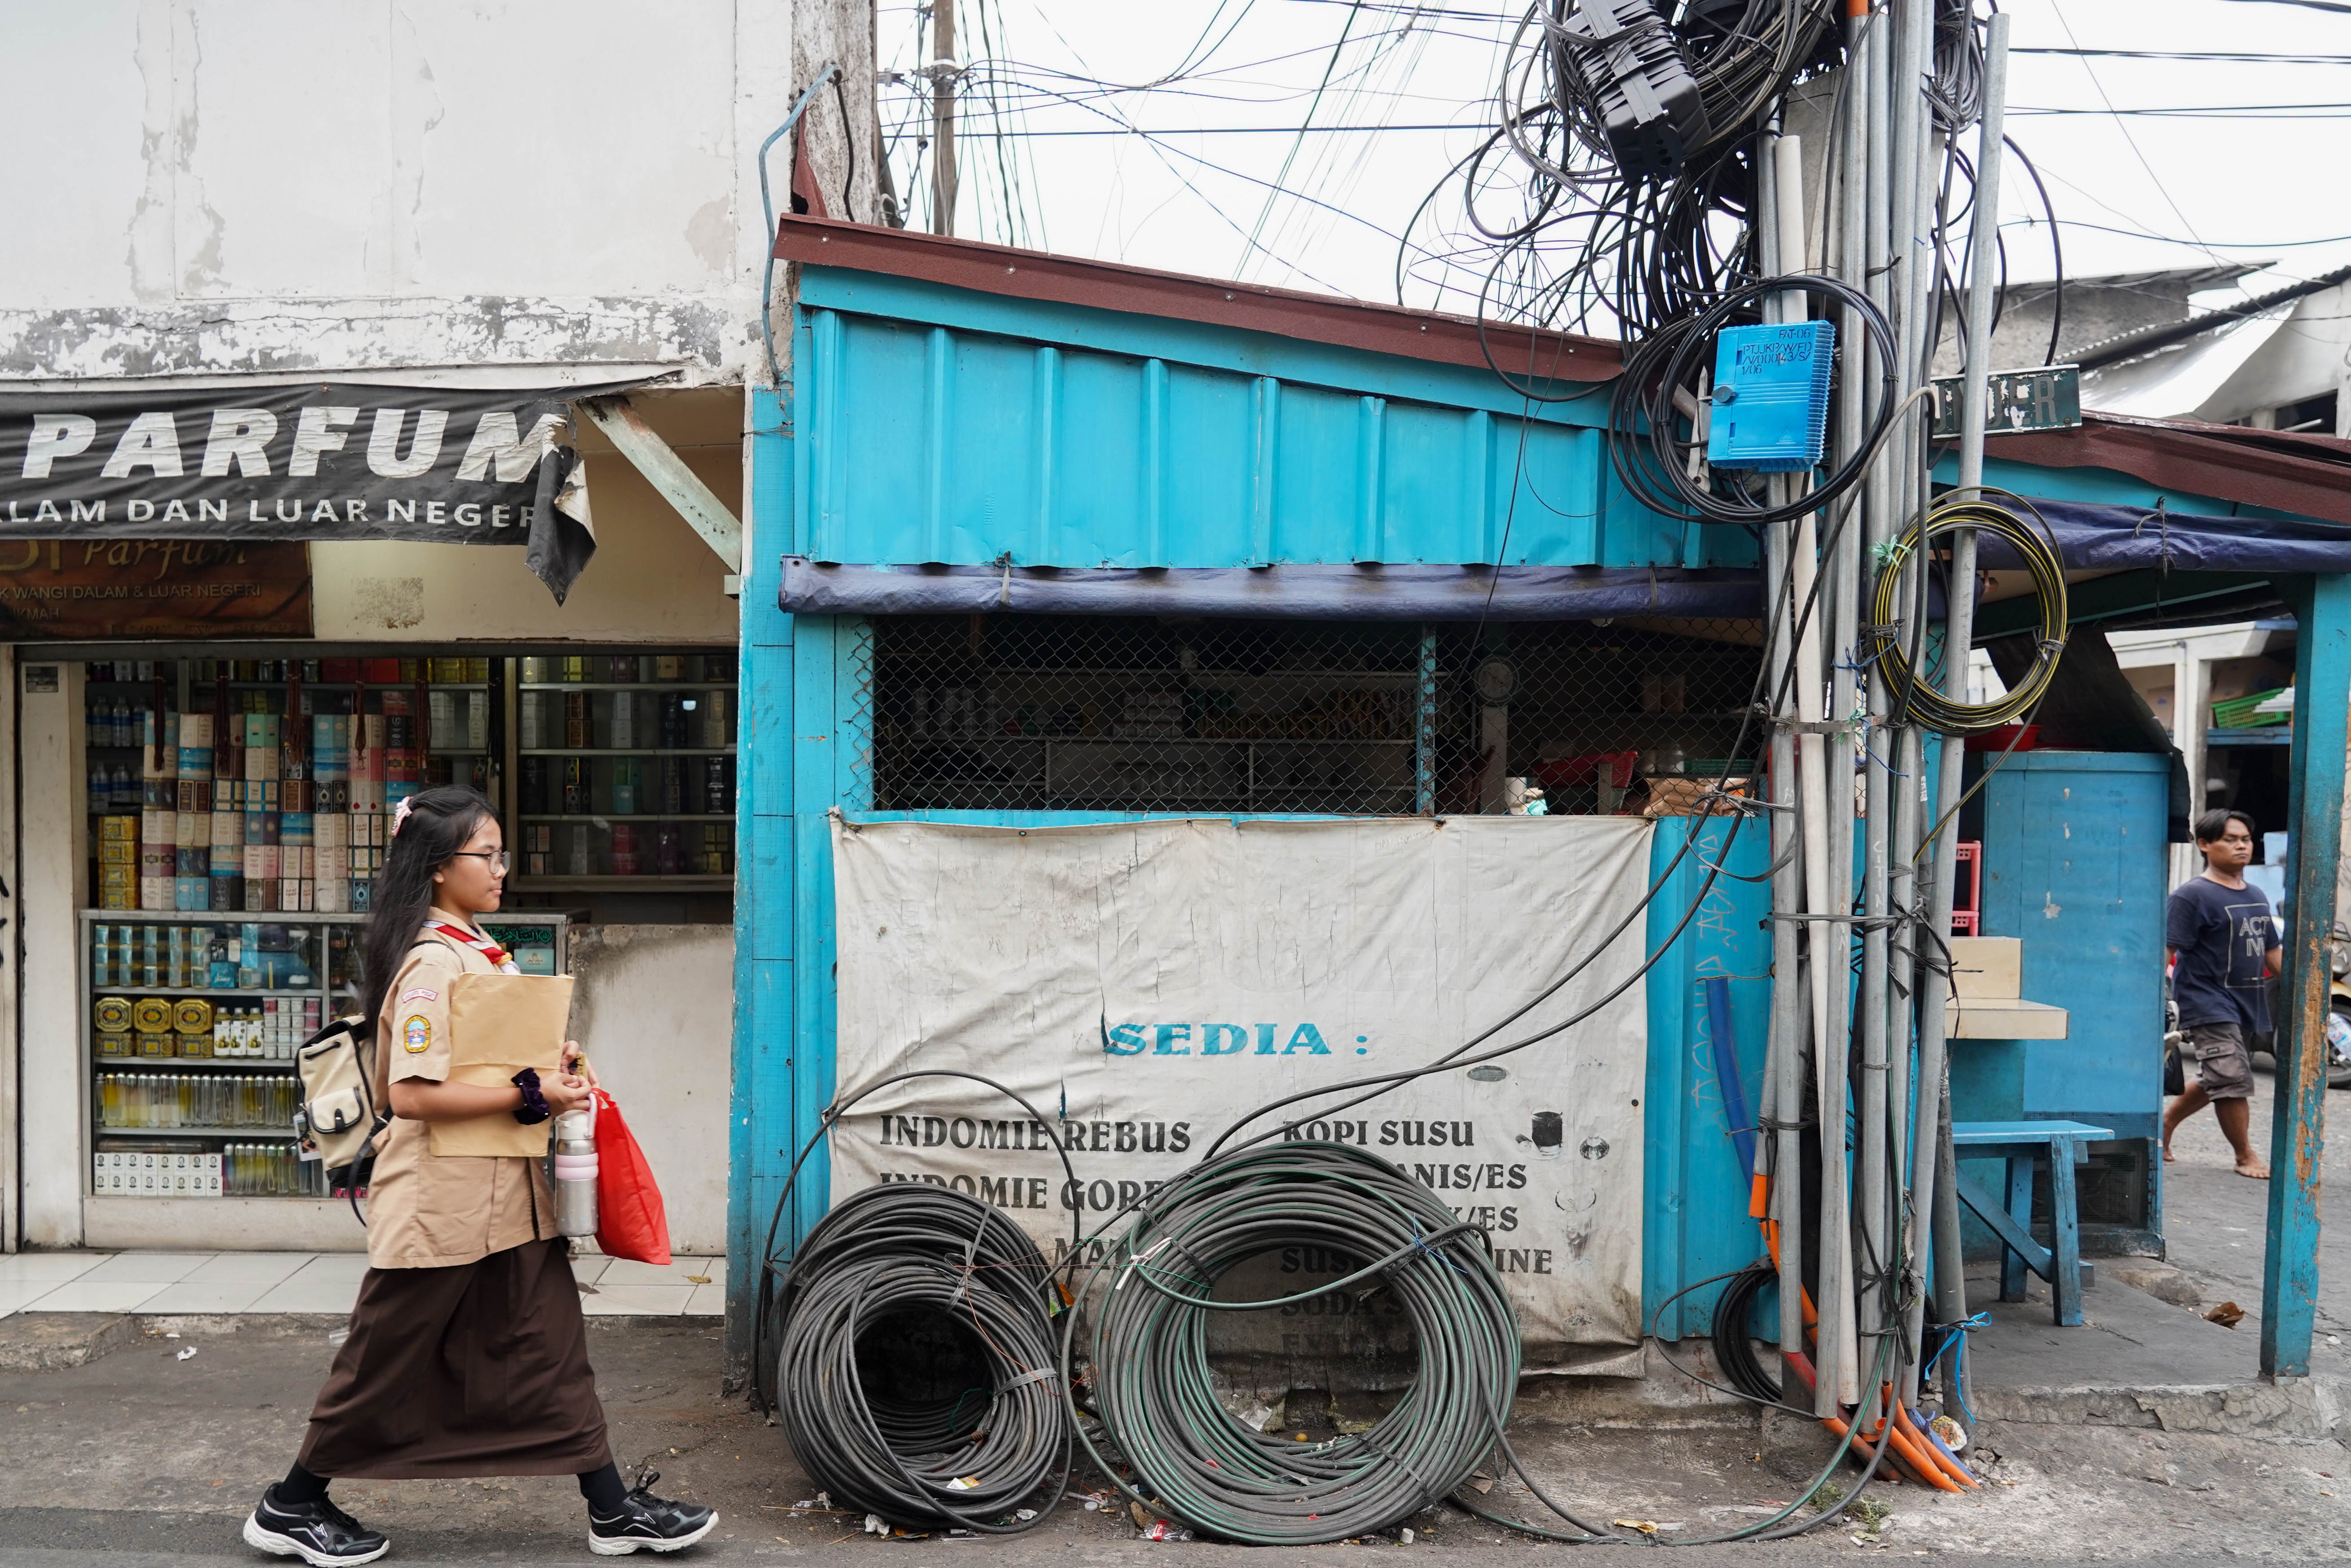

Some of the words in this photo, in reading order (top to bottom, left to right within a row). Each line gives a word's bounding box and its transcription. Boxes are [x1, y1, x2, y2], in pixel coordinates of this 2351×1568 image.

[21, 406, 568, 483] PARFUM
[0, 499, 106, 523] LAM
[128, 499, 228, 522] DAN
[250, 499, 369, 522] LUAR
[13, 587, 67, 599] WANGI
[73, 586, 128, 599] DALAM
[133, 586, 144, 598] &
[149, 585, 192, 598] LUAR
[197, 585, 261, 597] NEGERI
[2239, 916, 2270, 936] ACT
[1103, 1023, 1331, 1056] SEDIA
[880, 1115, 1050, 1151] INDOMIE
[1063, 1120, 1191, 1153] REBUS
[1283, 1120, 1368, 1145] KOPI
[1378, 1120, 1475, 1146] SUSU
